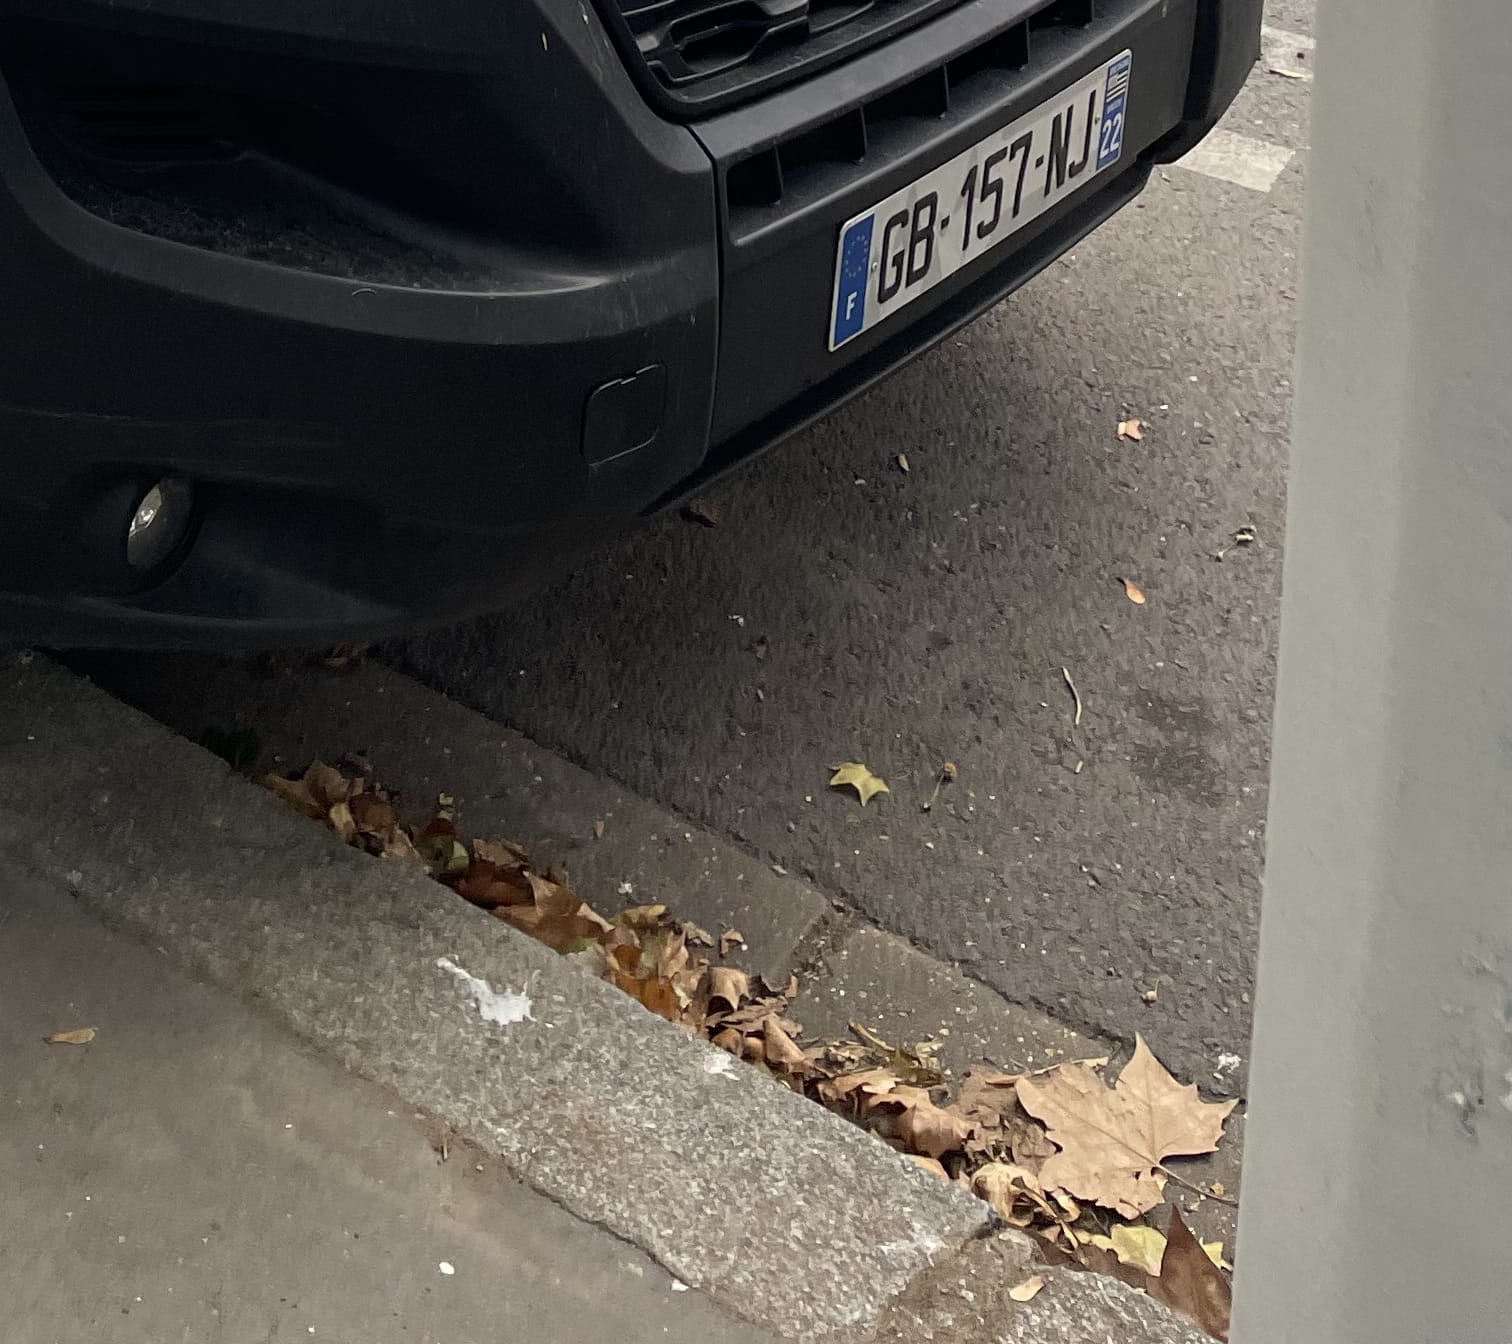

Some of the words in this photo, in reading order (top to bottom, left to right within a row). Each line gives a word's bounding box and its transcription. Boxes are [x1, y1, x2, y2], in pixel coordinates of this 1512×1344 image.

[845, 291, 858, 320] F
[877, 89, 1096, 304] GB-157-NJ
[1099, 112, 1122, 159] 22
